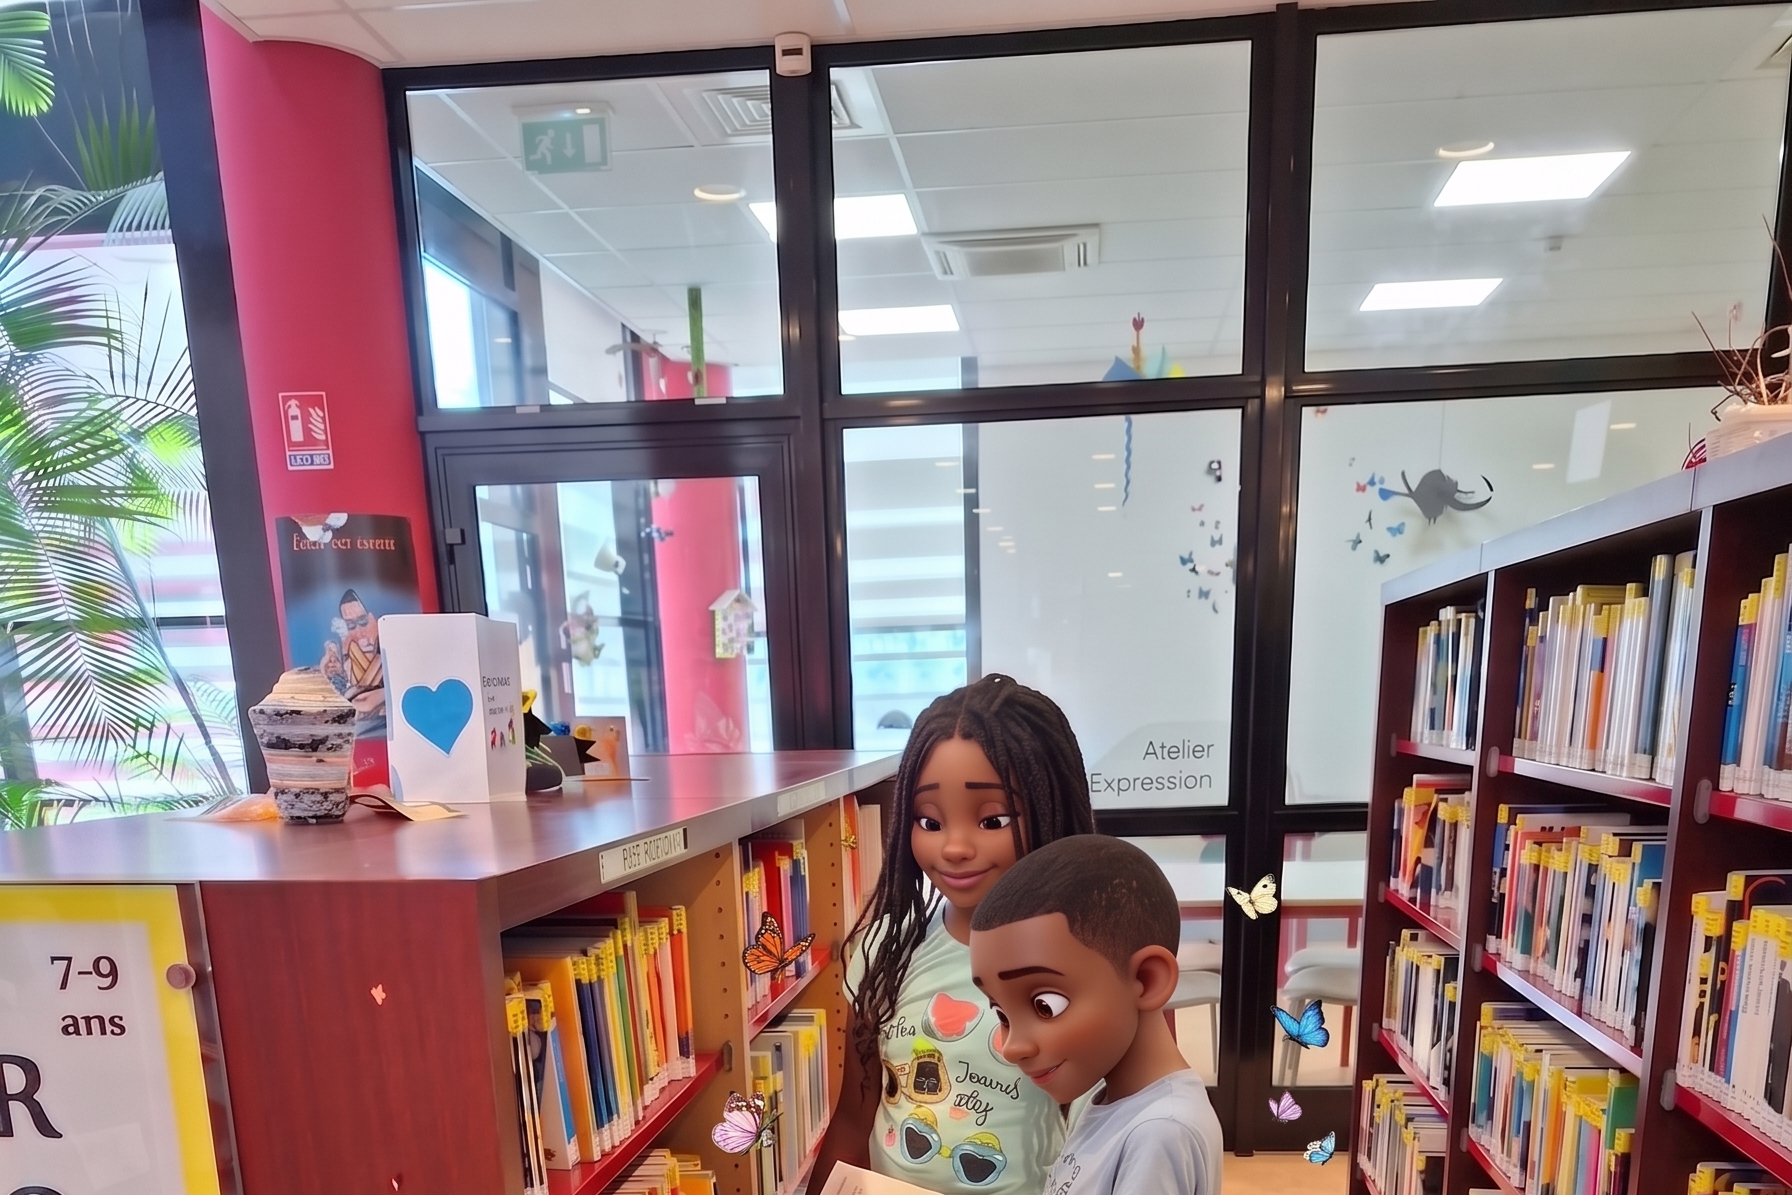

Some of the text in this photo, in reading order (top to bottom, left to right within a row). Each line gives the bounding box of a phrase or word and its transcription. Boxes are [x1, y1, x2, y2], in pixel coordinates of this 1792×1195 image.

[1142, 739, 1214, 761] Atelier
[1090, 770, 1212, 797] Expression
[50, 955, 119, 991] 7-9
[61, 1014, 127, 1036] ans
